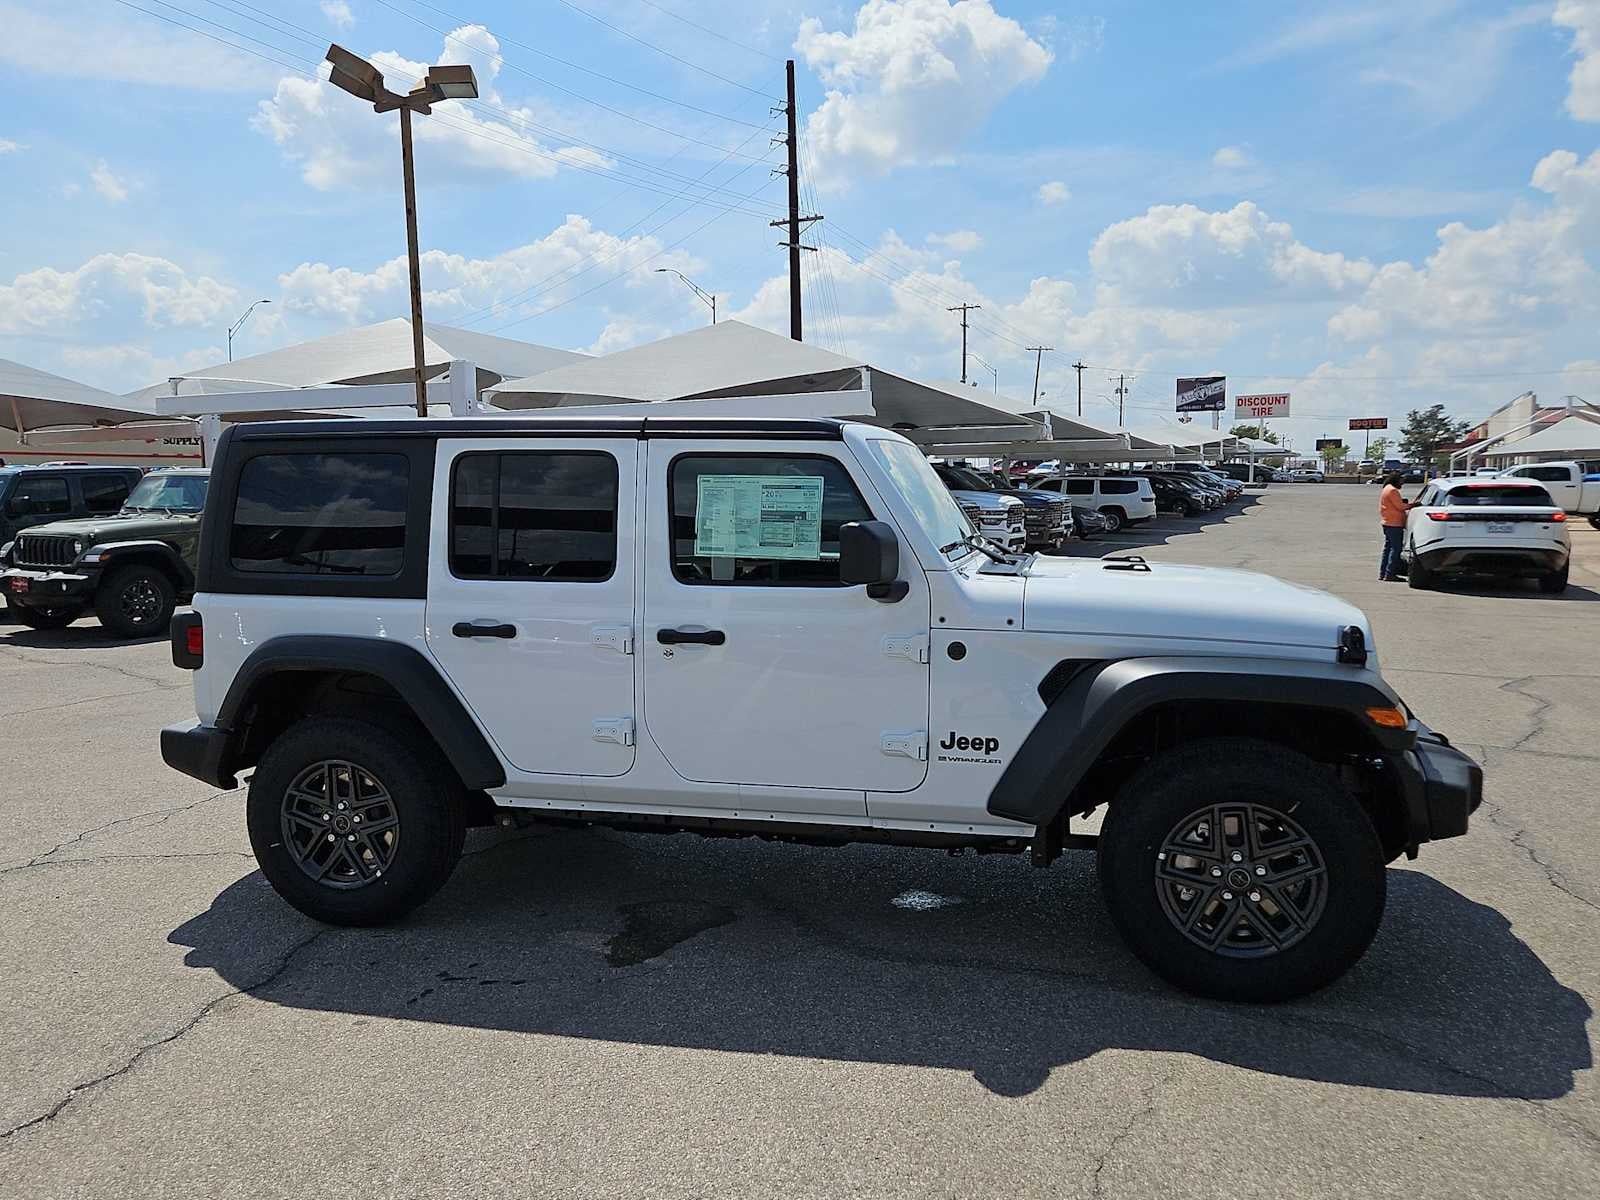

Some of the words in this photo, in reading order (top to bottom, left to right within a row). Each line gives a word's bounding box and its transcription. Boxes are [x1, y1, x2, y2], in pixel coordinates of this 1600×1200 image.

[1237, 396, 1287, 407] DISCOUNT
[1251, 407, 1273, 416] TIRE
[163, 437, 201, 446] SUPPLY
[940, 731, 1000, 755] Jeep
[947, 756, 1002, 765] WRANGLER
